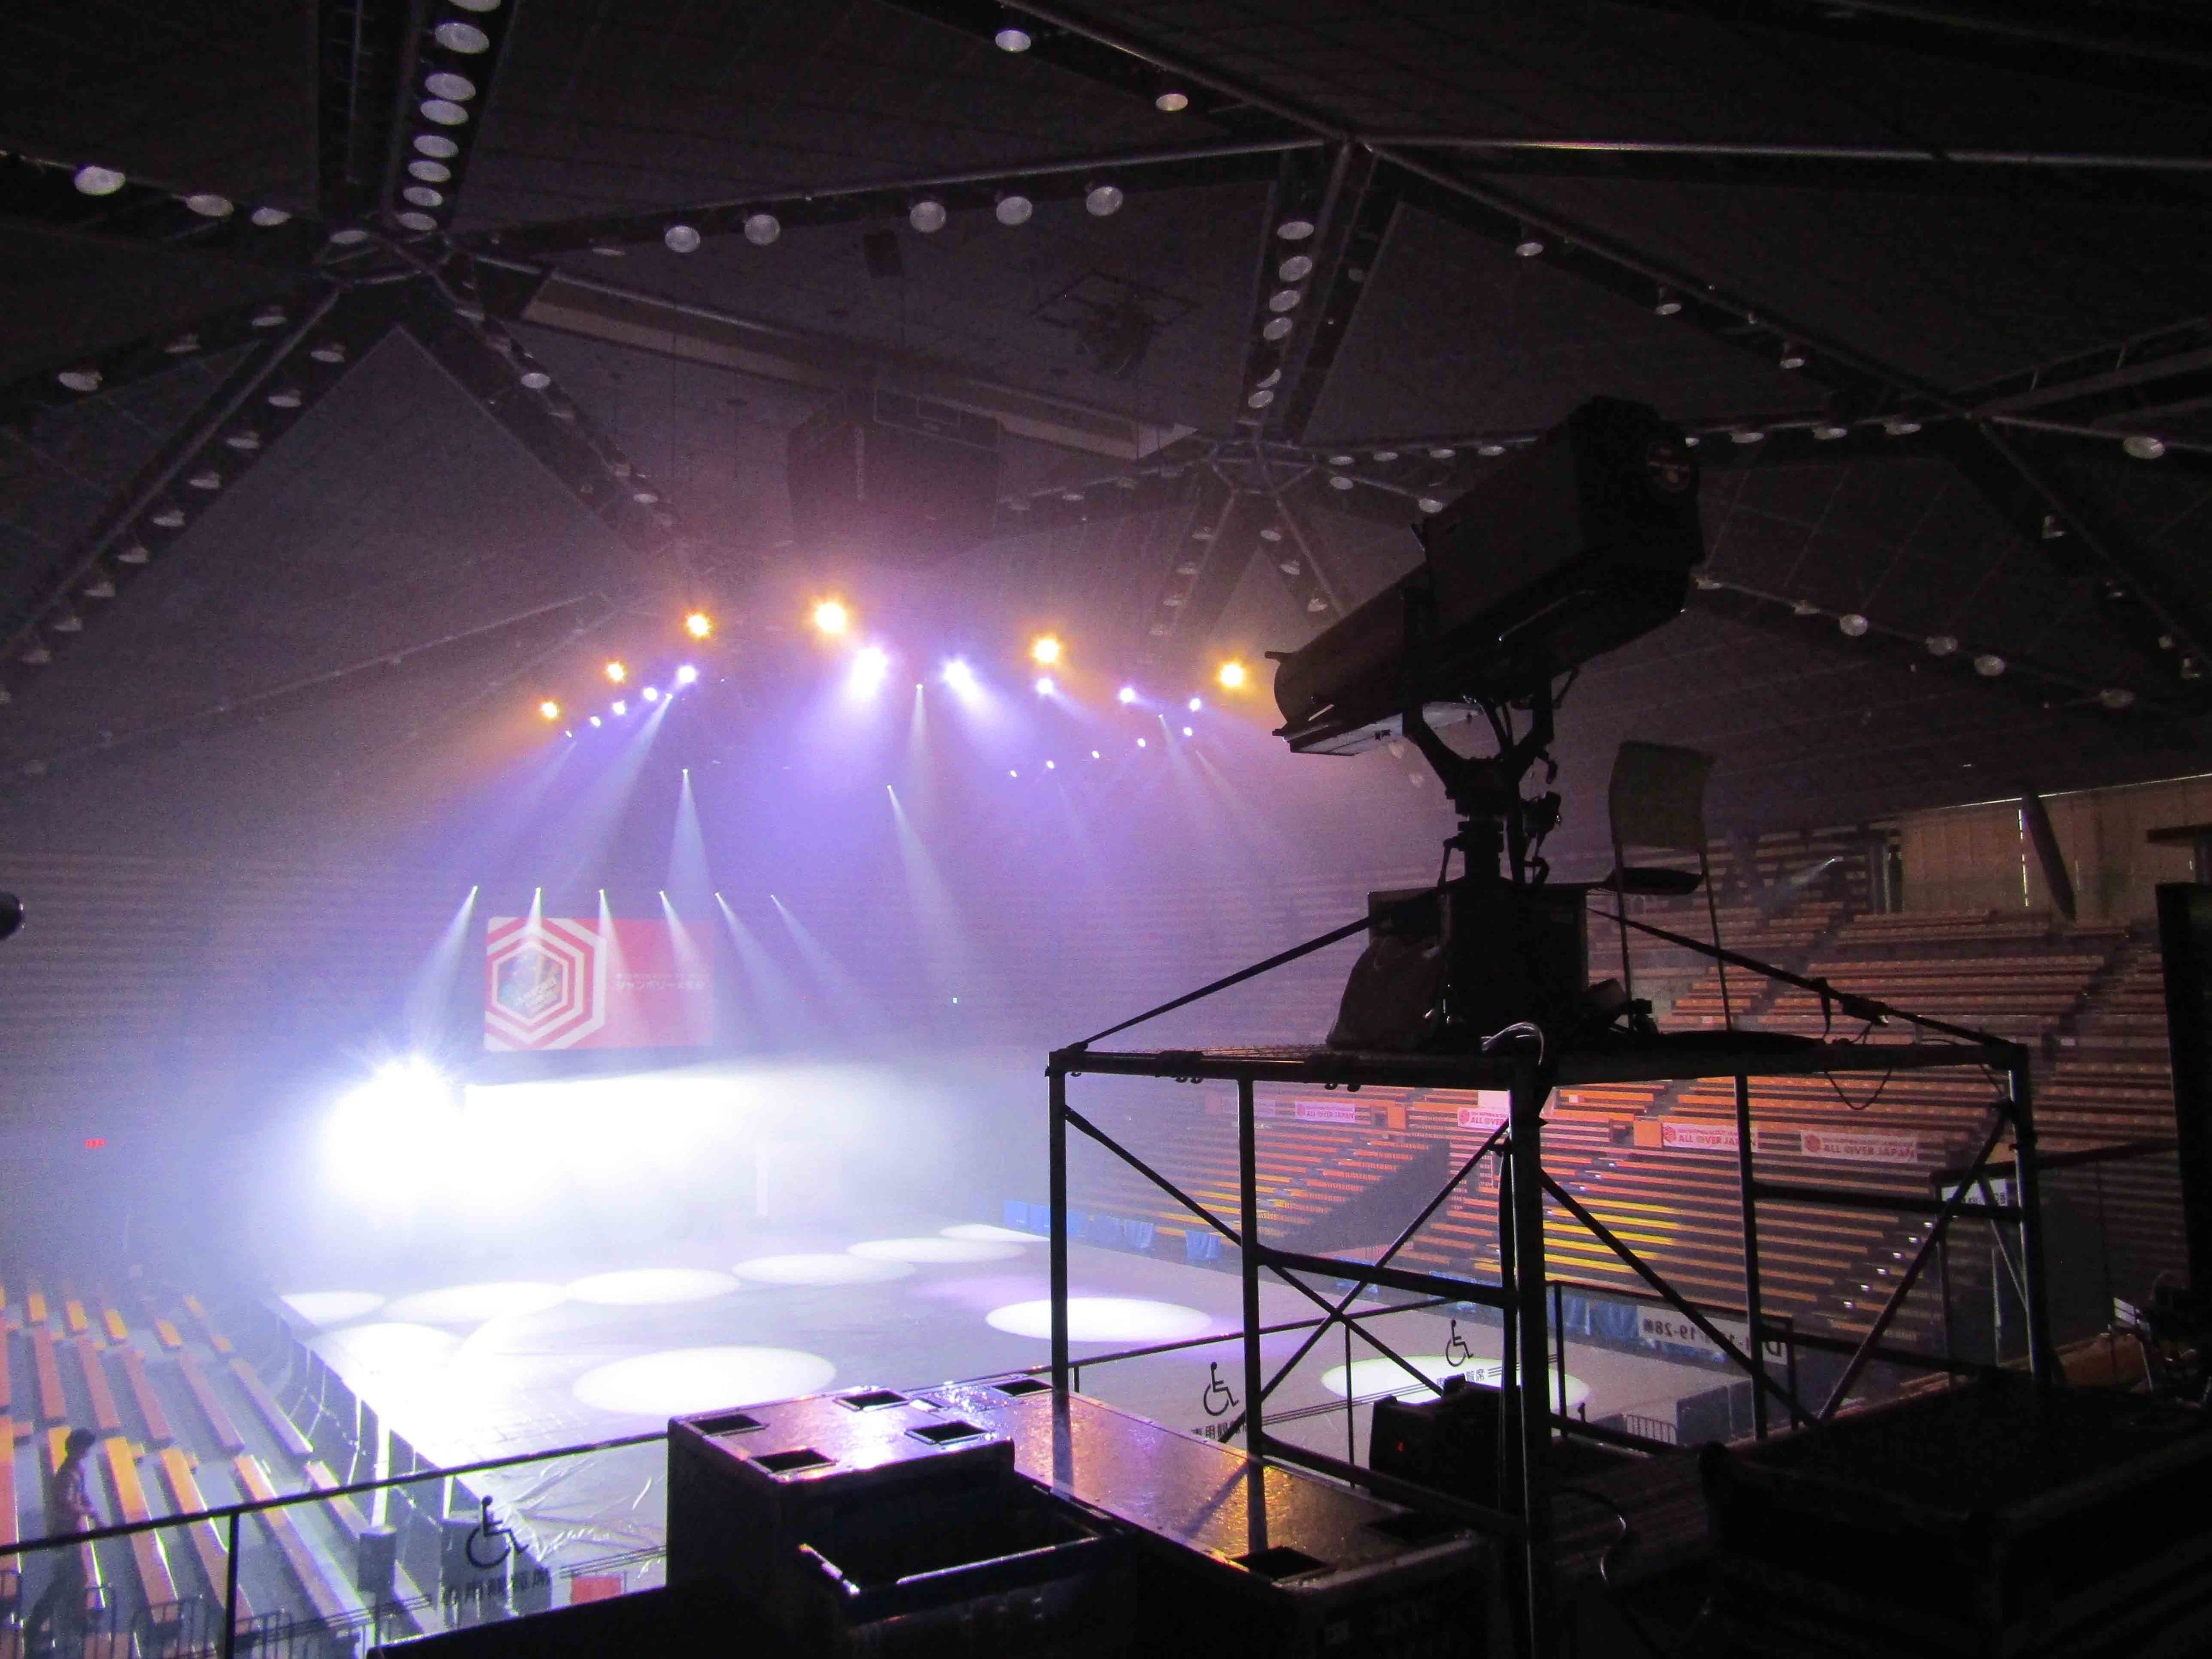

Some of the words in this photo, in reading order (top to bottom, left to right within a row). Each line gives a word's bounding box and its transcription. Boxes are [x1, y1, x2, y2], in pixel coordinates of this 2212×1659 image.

[1679, 1134, 1694, 1143] ALL
[1696, 1135, 1721, 1145] OVER
[1825, 1143, 1842, 1153] ALL
[1844, 1145, 1875, 1155] OVER
[1878, 1147, 1916, 1158] JAPAN
